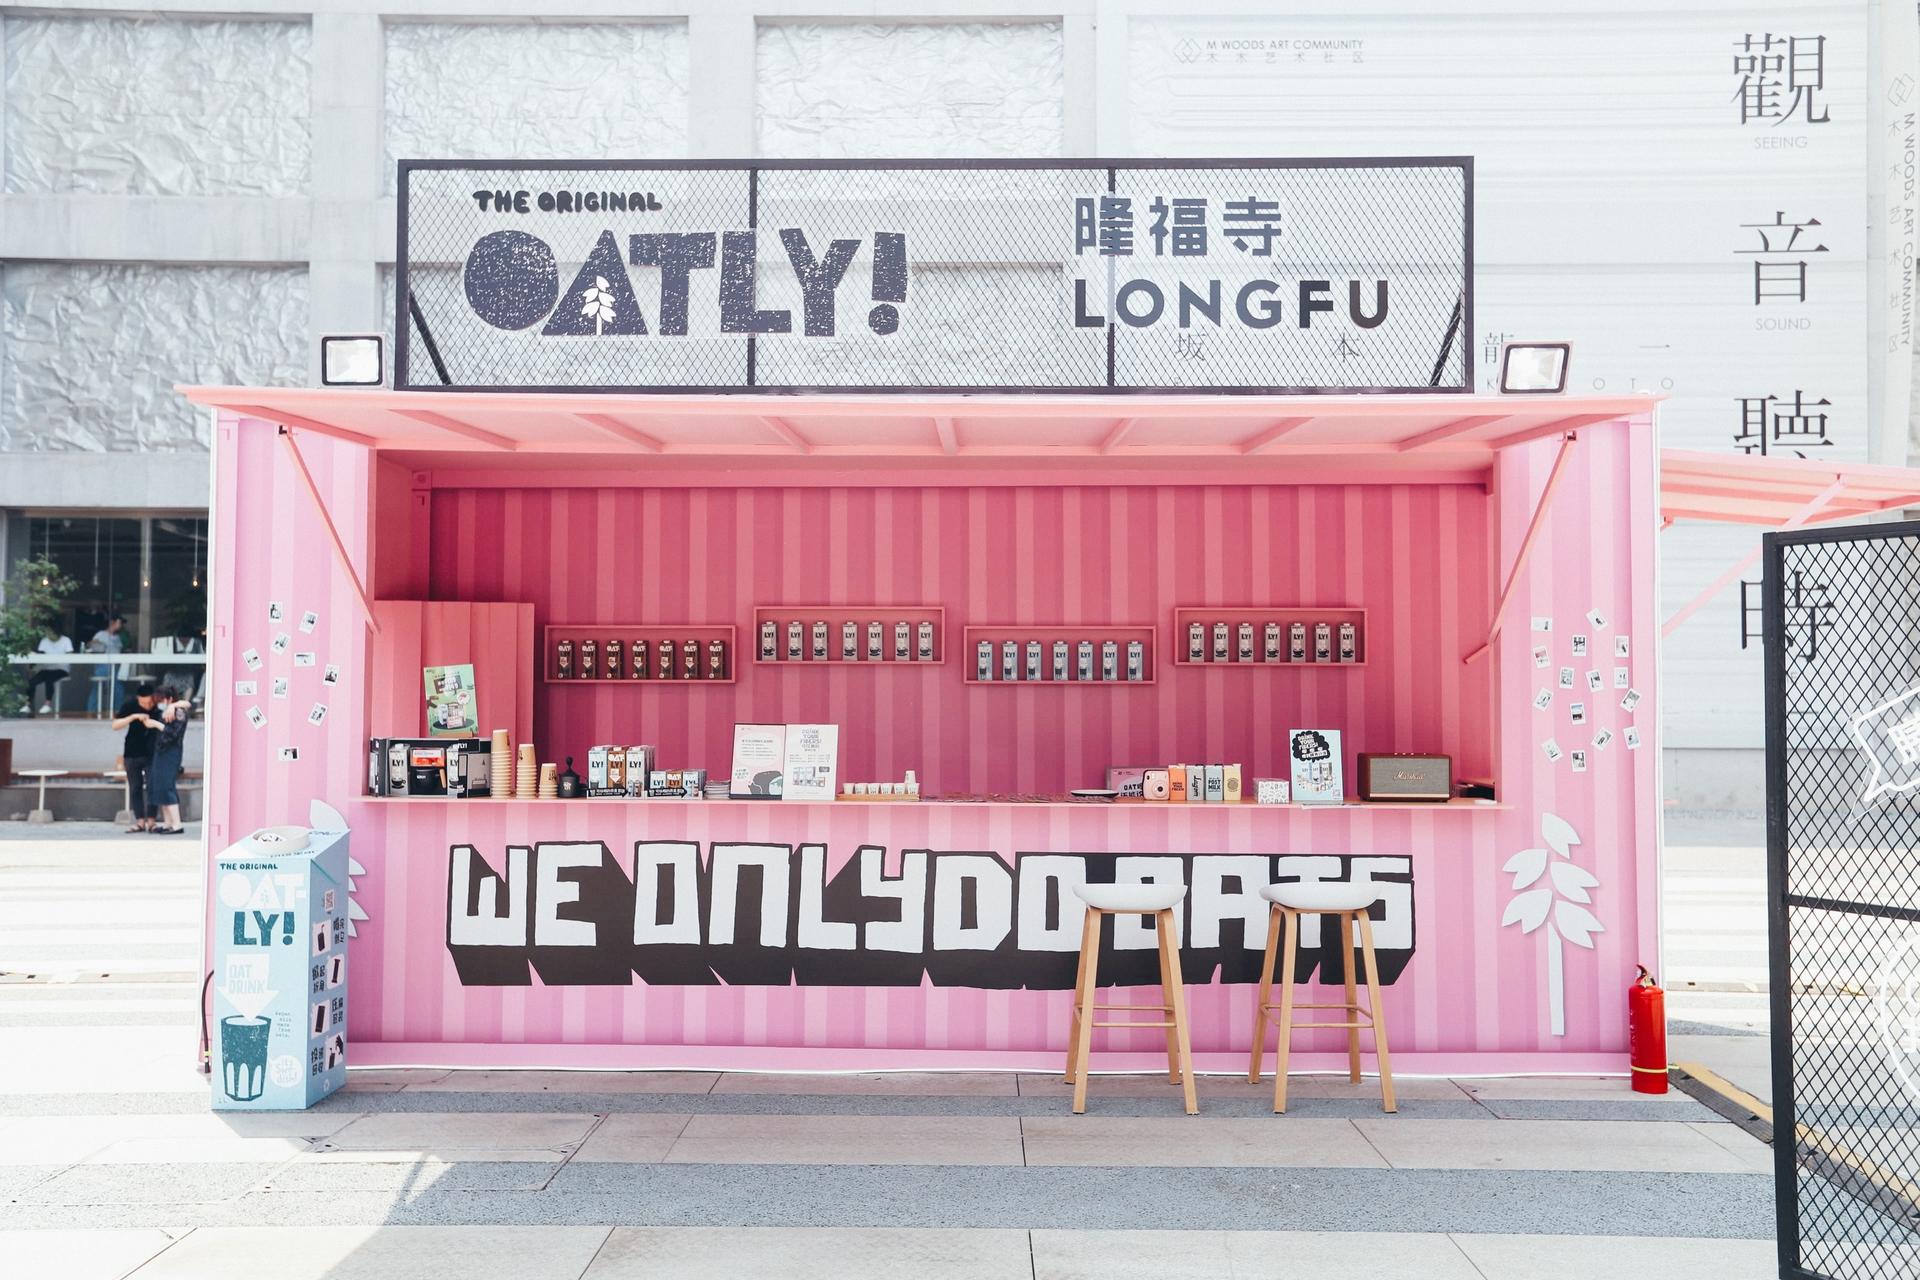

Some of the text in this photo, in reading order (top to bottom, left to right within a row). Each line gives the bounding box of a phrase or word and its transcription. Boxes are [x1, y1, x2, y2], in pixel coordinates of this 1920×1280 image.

[1206, 40, 1364, 49] M WOODS ART COMMUNITY
[1730, 33, 1831, 127] 觀
[1754, 136, 1808, 149] SEEING
[472, 190, 662, 214] THE ORIGINAL
[1075, 196, 1282, 257] 隆福寺
[1900, 112, 1915, 346] M WOODS ART COMMUNITY
[1733, 211, 1830, 305] 音
[464, 228, 908, 337] OATLY!
[1075, 278, 1388, 330] LONGFU
[1755, 318, 1811, 332] SOUND
[220, 863, 278, 871] THE ORIGINAL
[447, 841, 1412, 955] WE ONLY DO OATS
[233, 911, 296, 947] LY!
[229, 964, 252, 978] OAT
[229, 980, 265, 994] DRINK
